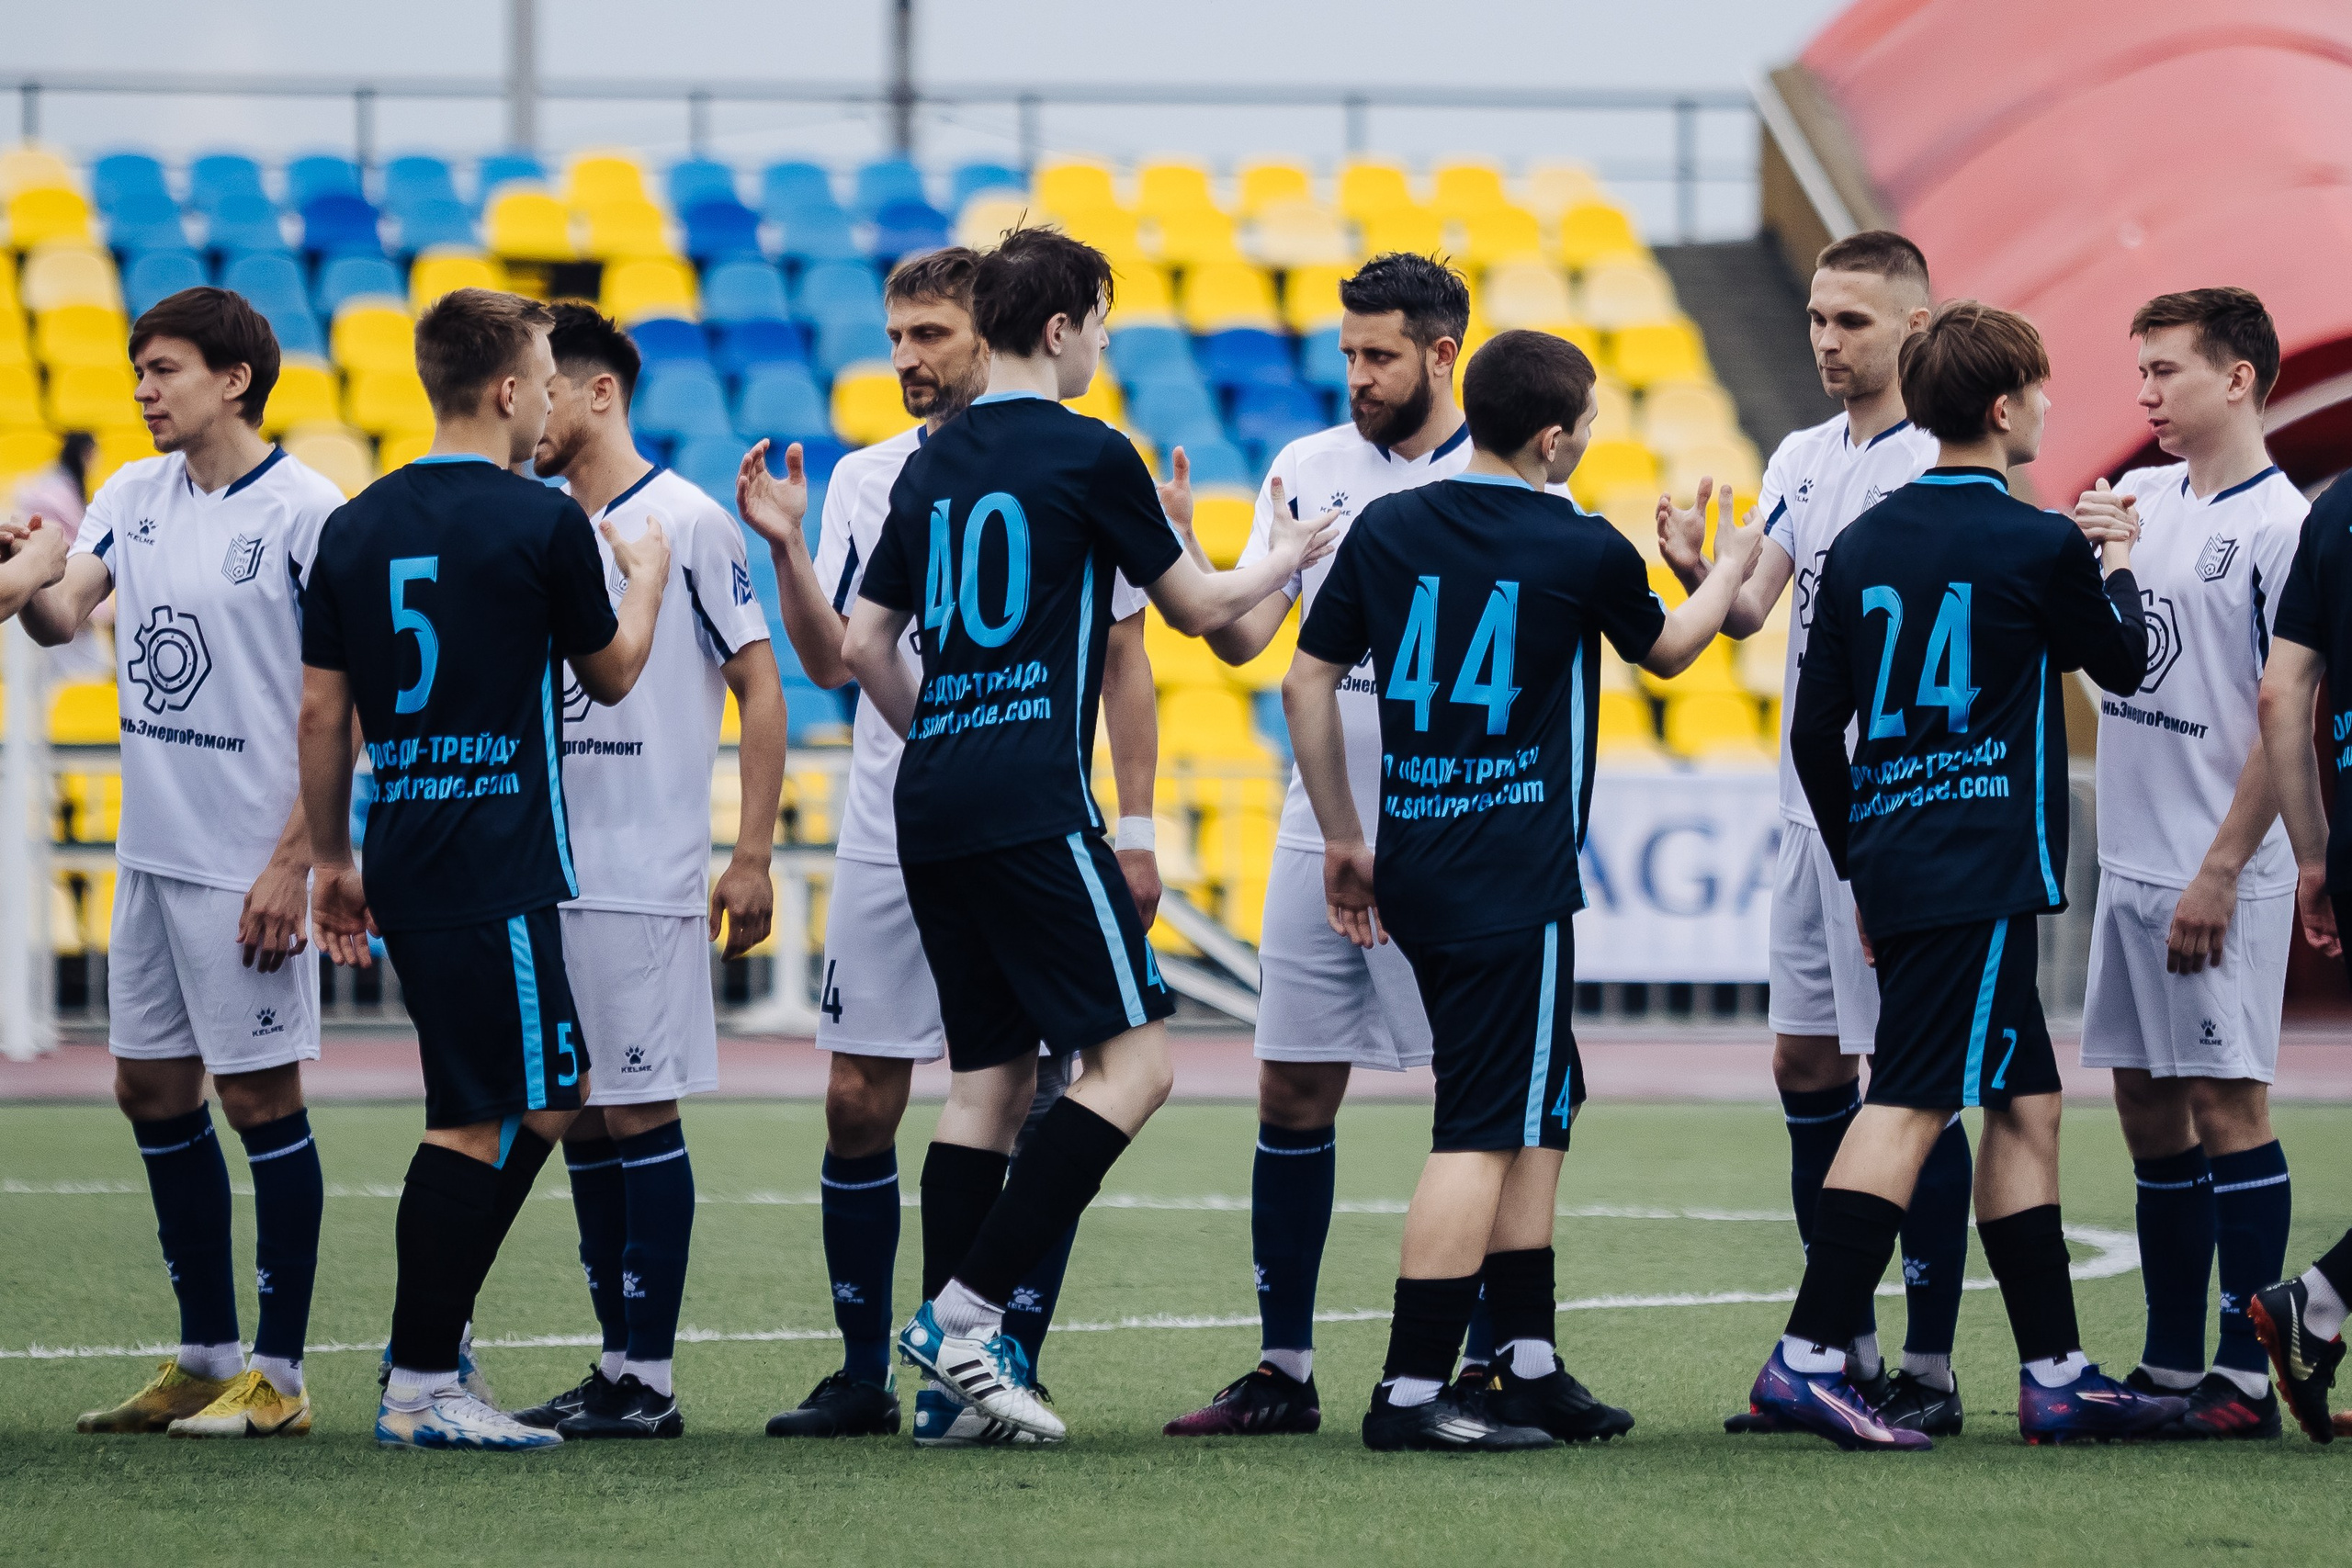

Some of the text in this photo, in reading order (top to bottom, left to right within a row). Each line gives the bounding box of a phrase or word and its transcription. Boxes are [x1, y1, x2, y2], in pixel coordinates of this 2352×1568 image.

[127, 531, 155, 546] KELME
[1320, 506, 1351, 516] KEME
[924, 491, 1031, 654] 40
[389, 555, 439, 715] 5
[1385, 575, 1523, 736] 44
[1861, 581, 1982, 741] 24
[820, 959, 843, 1024] 4
[252, 1025, 285, 1037] KELME
[557, 1022, 579, 1086] 5
[1991, 1028, 2018, 1090] 2
[621, 1065, 652, 1074] KELME
[1551, 1066, 1570, 1129] 4
